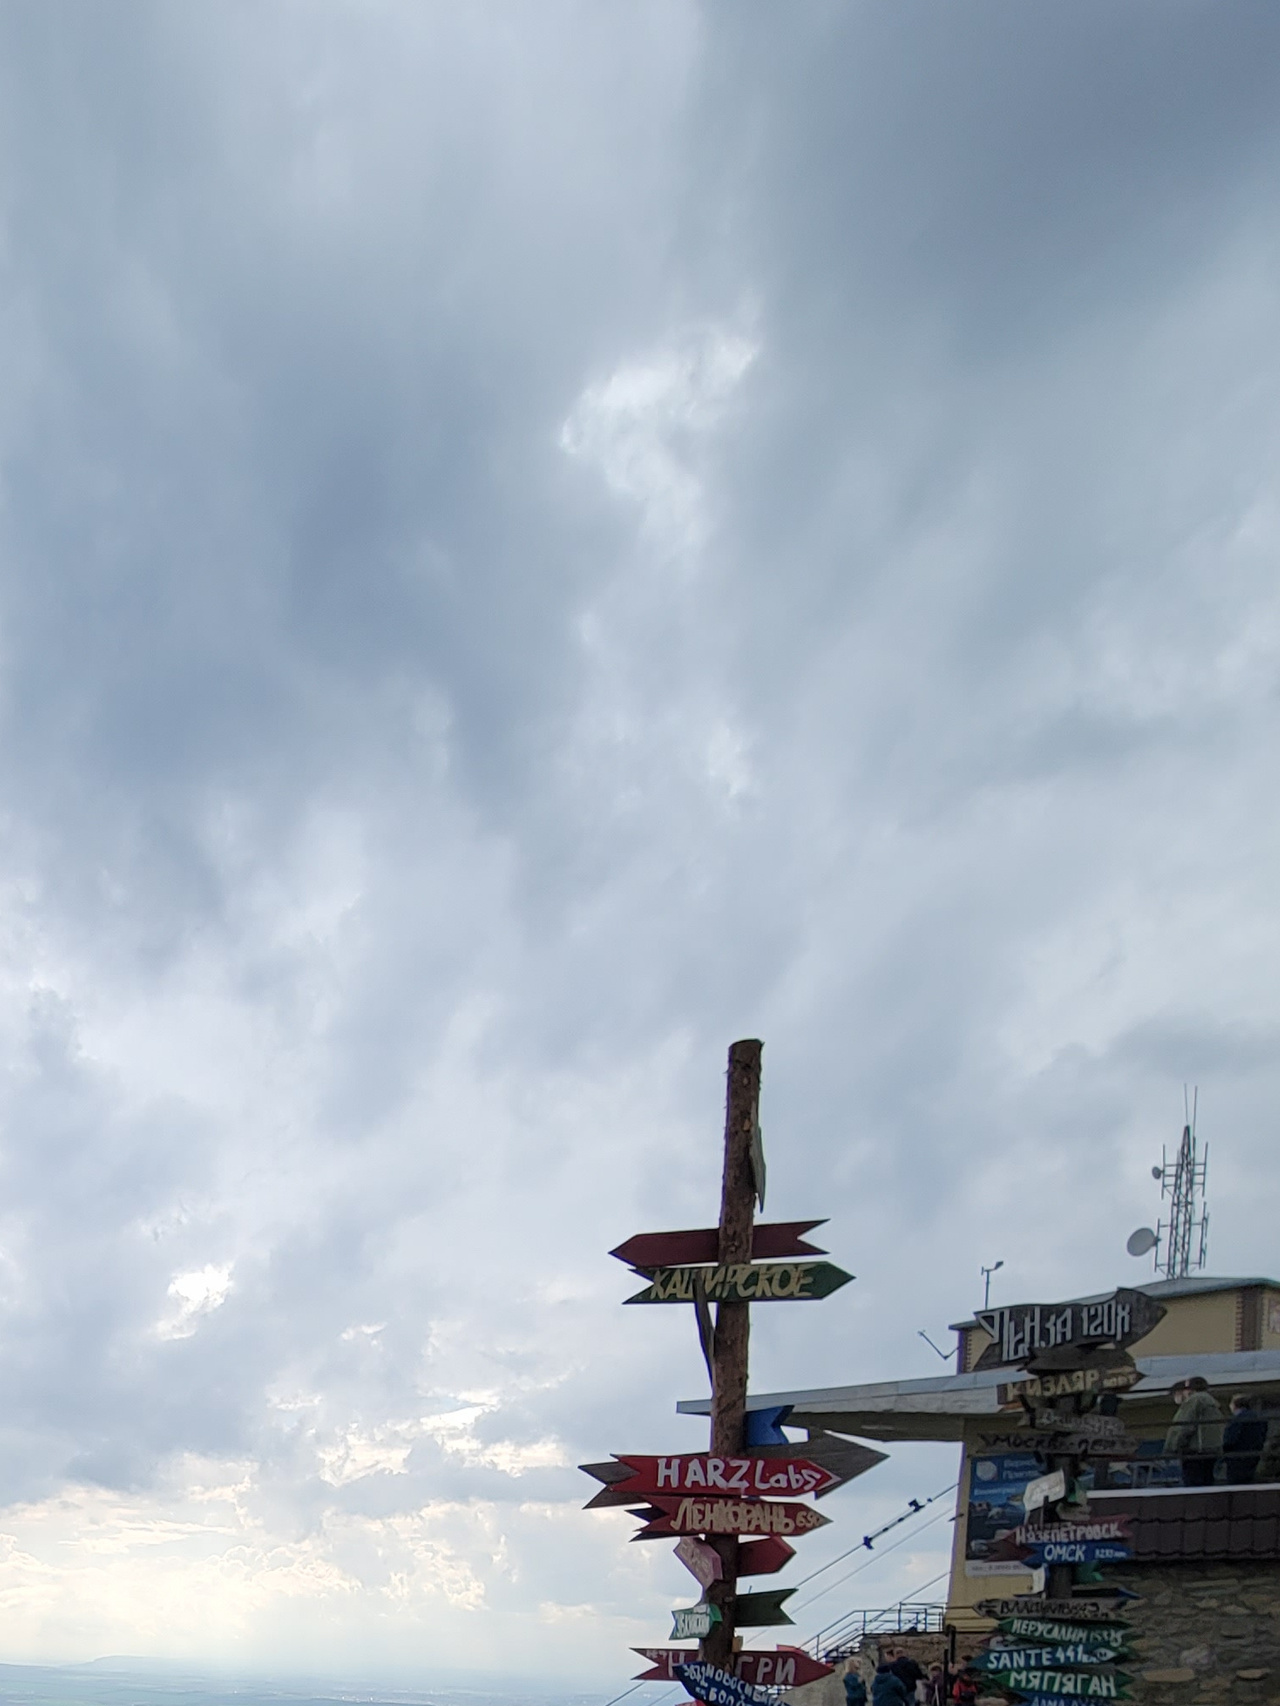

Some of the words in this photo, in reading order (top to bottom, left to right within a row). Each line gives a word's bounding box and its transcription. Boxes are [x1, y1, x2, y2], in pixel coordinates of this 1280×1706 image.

[1006, 1369, 1100, 1402] КИЗЛЯР
[656, 1457, 751, 1489] HARZ
[754, 1460, 821, 1491] Labs
[1043, 1544, 1086, 1563] ОМСК
[1011, 1618, 1087, 1644] ИЕРУСАЛИМ
[986, 1647, 1053, 1670] SANTE
